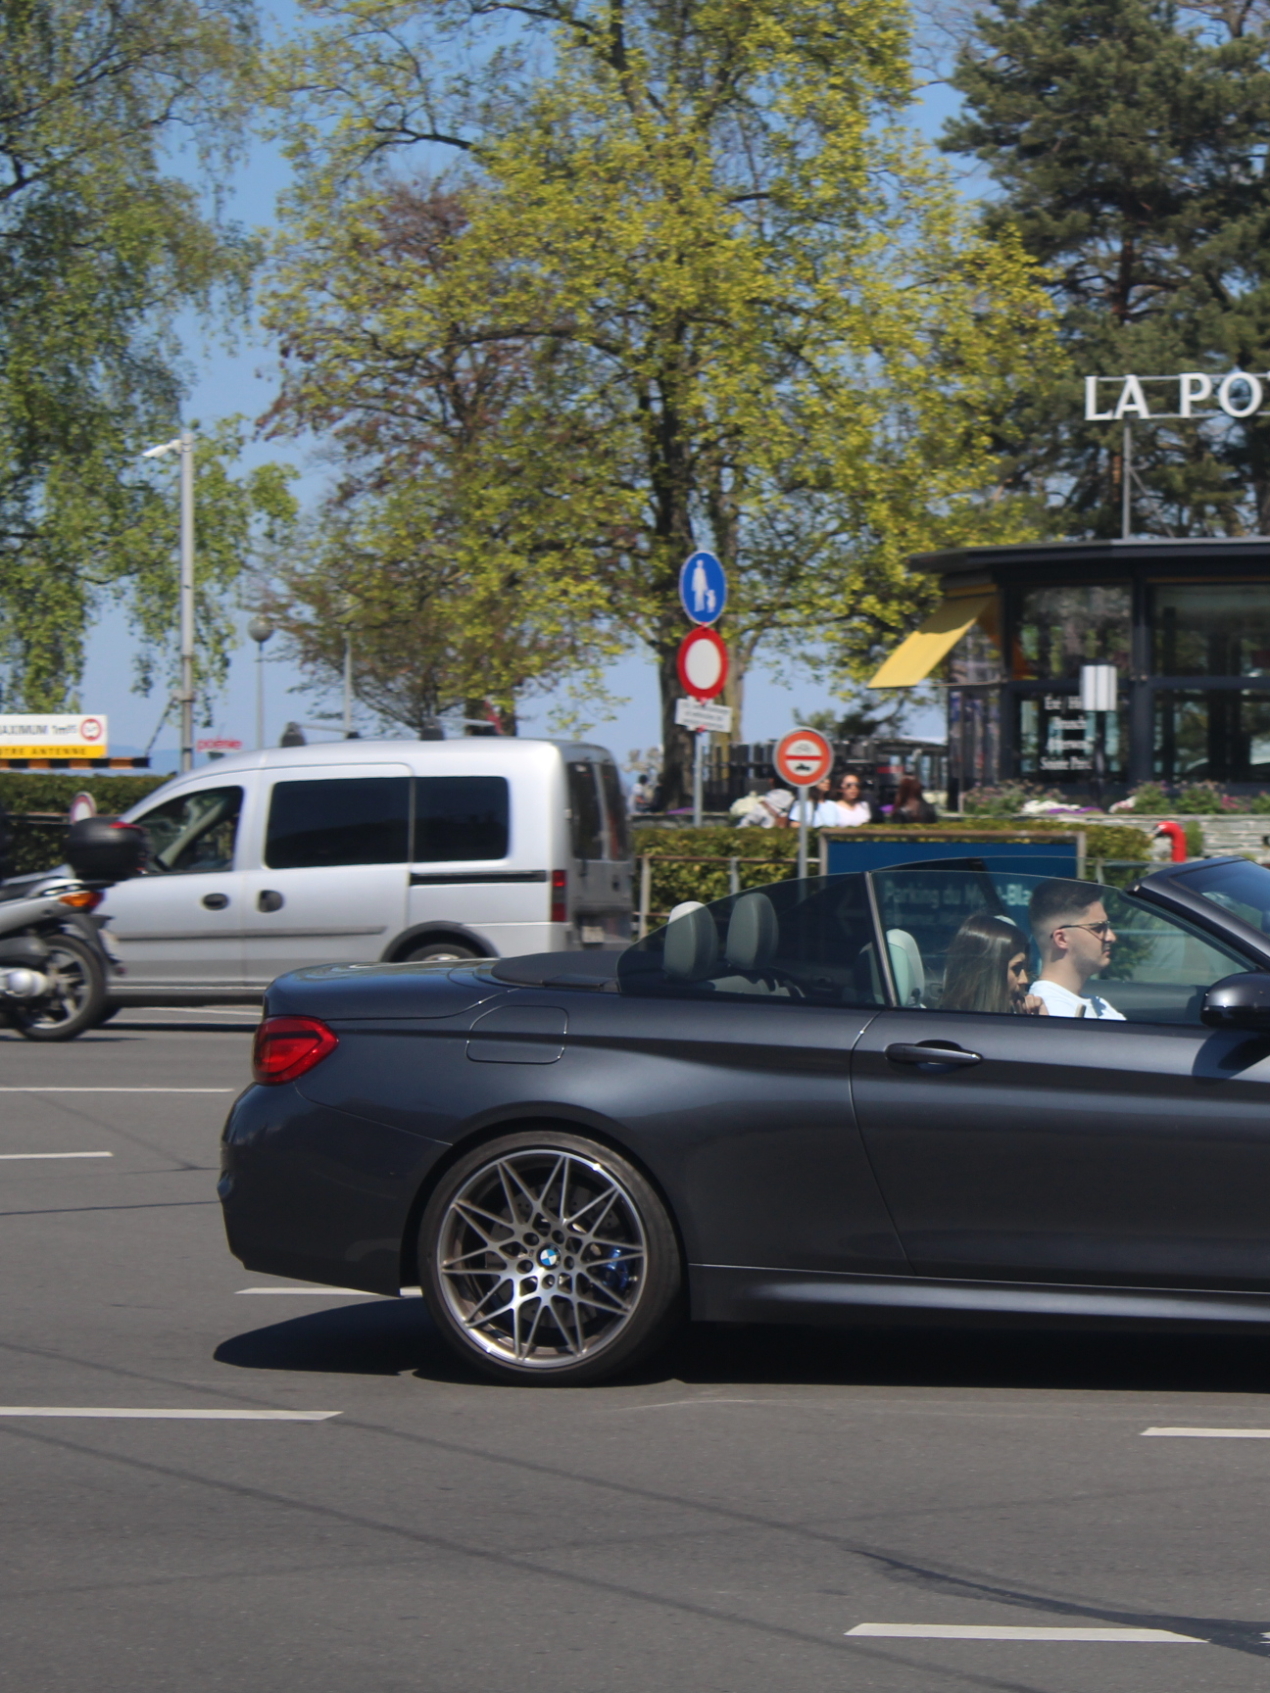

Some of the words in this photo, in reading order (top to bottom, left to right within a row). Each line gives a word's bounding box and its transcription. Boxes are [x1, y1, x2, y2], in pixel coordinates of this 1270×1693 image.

[1084, 374, 1150, 421] LA
[0, 748, 24, 756] TRE
[31, 748, 86, 756] ANTENNE
